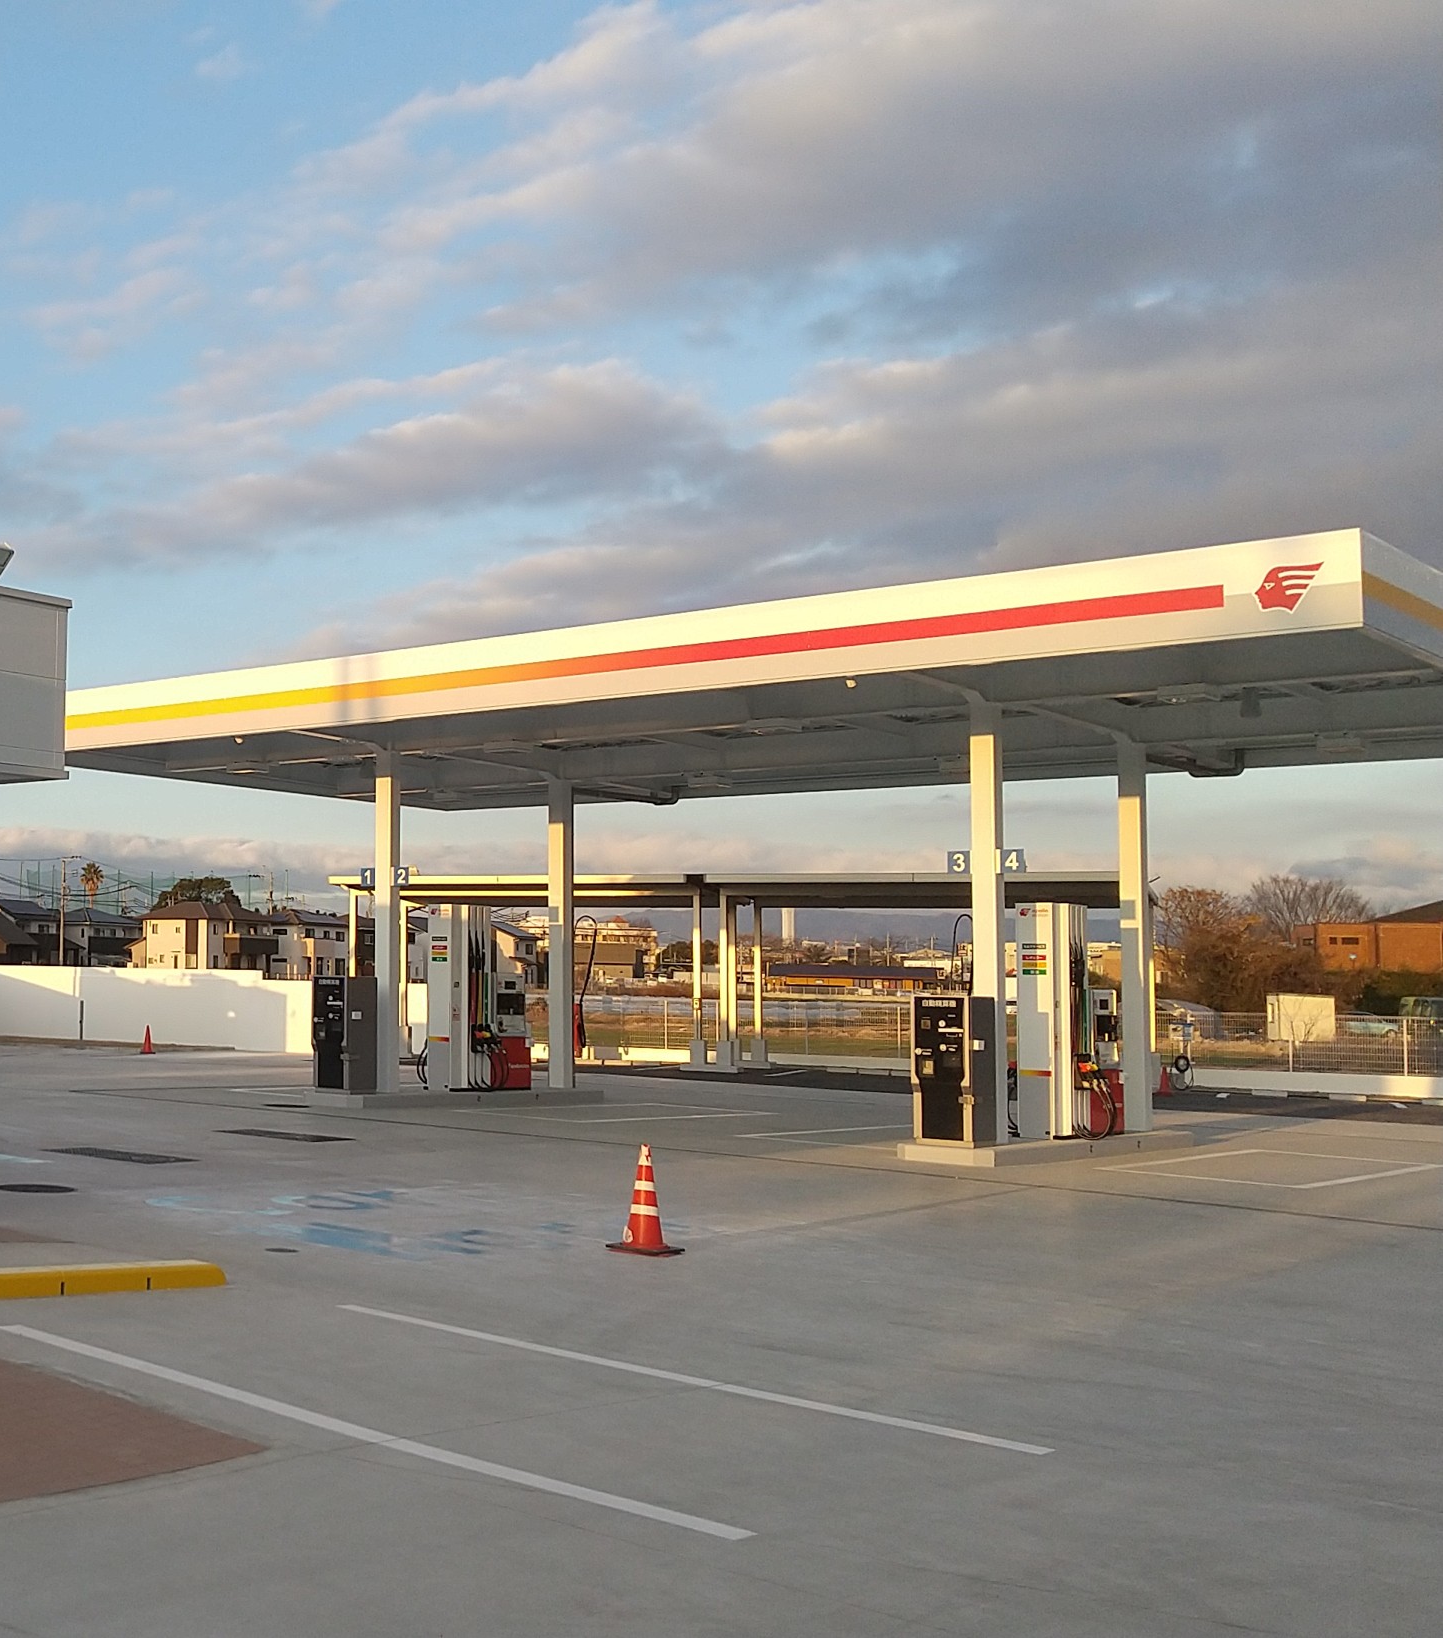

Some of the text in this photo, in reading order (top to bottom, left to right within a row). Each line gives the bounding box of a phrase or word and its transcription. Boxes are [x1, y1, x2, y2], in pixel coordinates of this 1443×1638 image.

[952, 854, 965, 872] 3
[1005, 852, 1019, 871] 4
[364, 869, 373, 884] 1
[395, 869, 408, 884] 2
